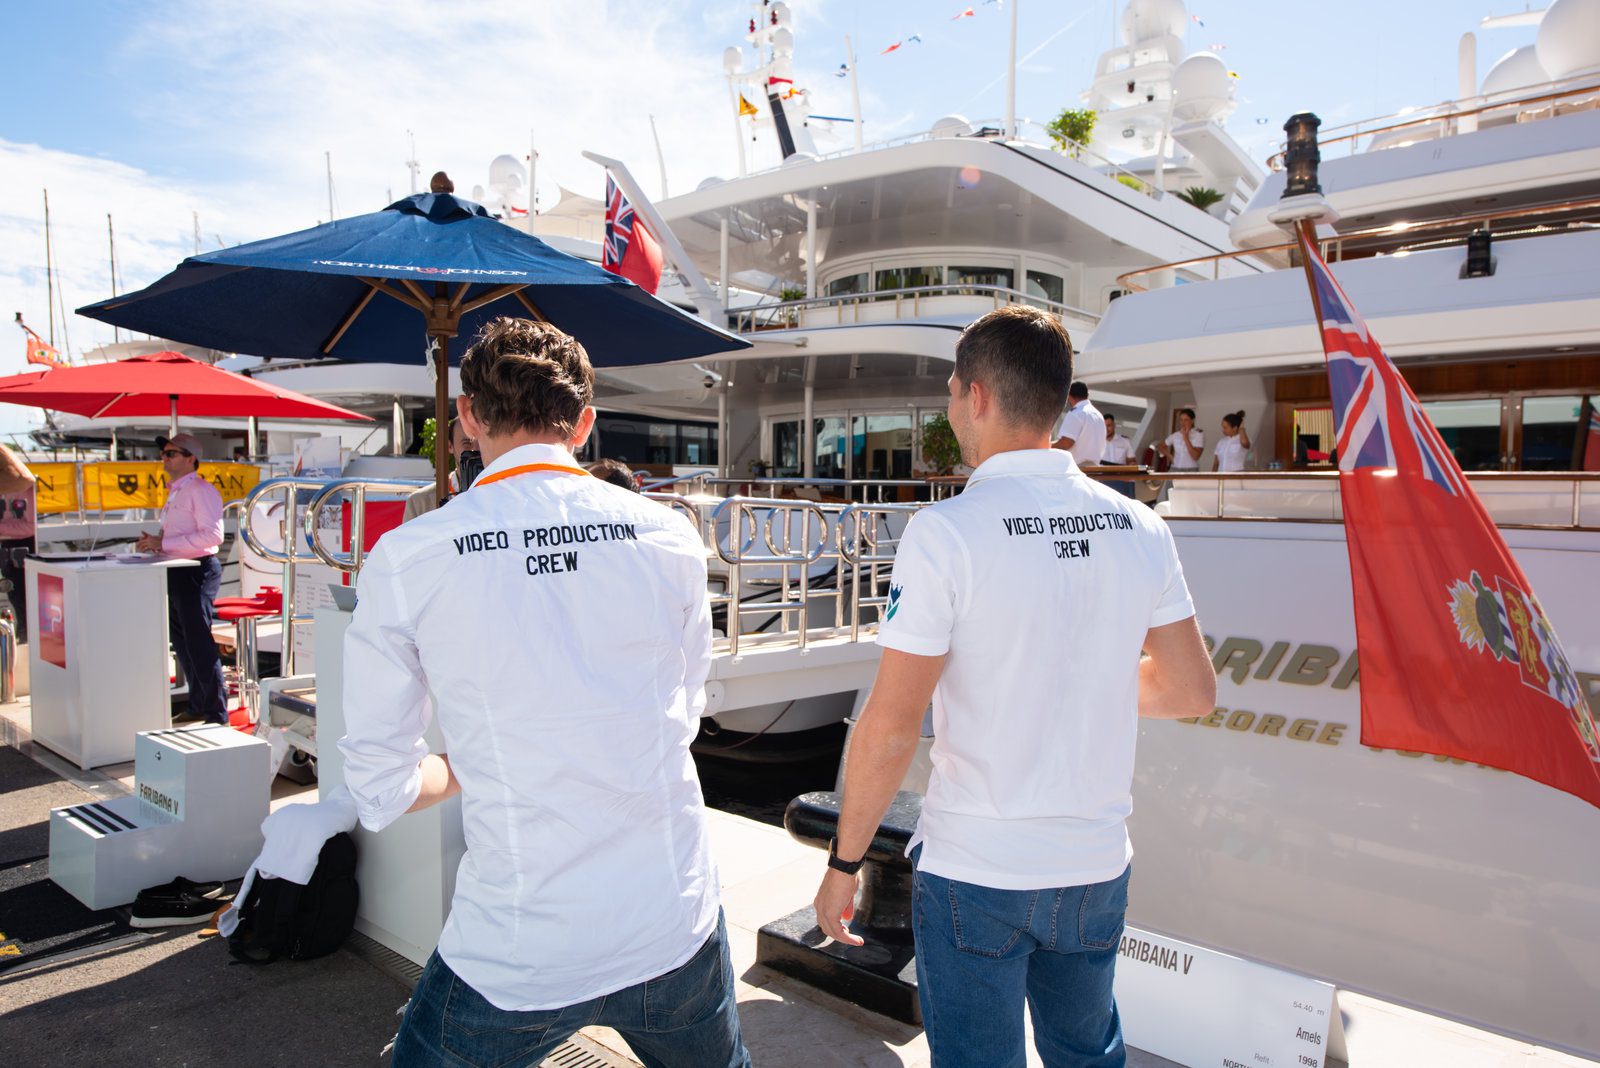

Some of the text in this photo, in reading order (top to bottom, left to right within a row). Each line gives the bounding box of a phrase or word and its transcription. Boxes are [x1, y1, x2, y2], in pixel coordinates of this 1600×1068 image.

[441, 267, 528, 276] JOHNSON
[1003, 513, 1133, 536] VIDEO PRODUCTION
[453, 524, 638, 555] VIDEO PRODUCTION
[1053, 539, 1090, 559] CREW
[526, 551, 578, 576] CREW
[140, 783, 179, 815] FARIBANA V
[1117, 935, 1193, 975] ARIBANA V
[1296, 1027, 1322, 1045] Amels
[1298, 1055, 1318, 1068] 1998
